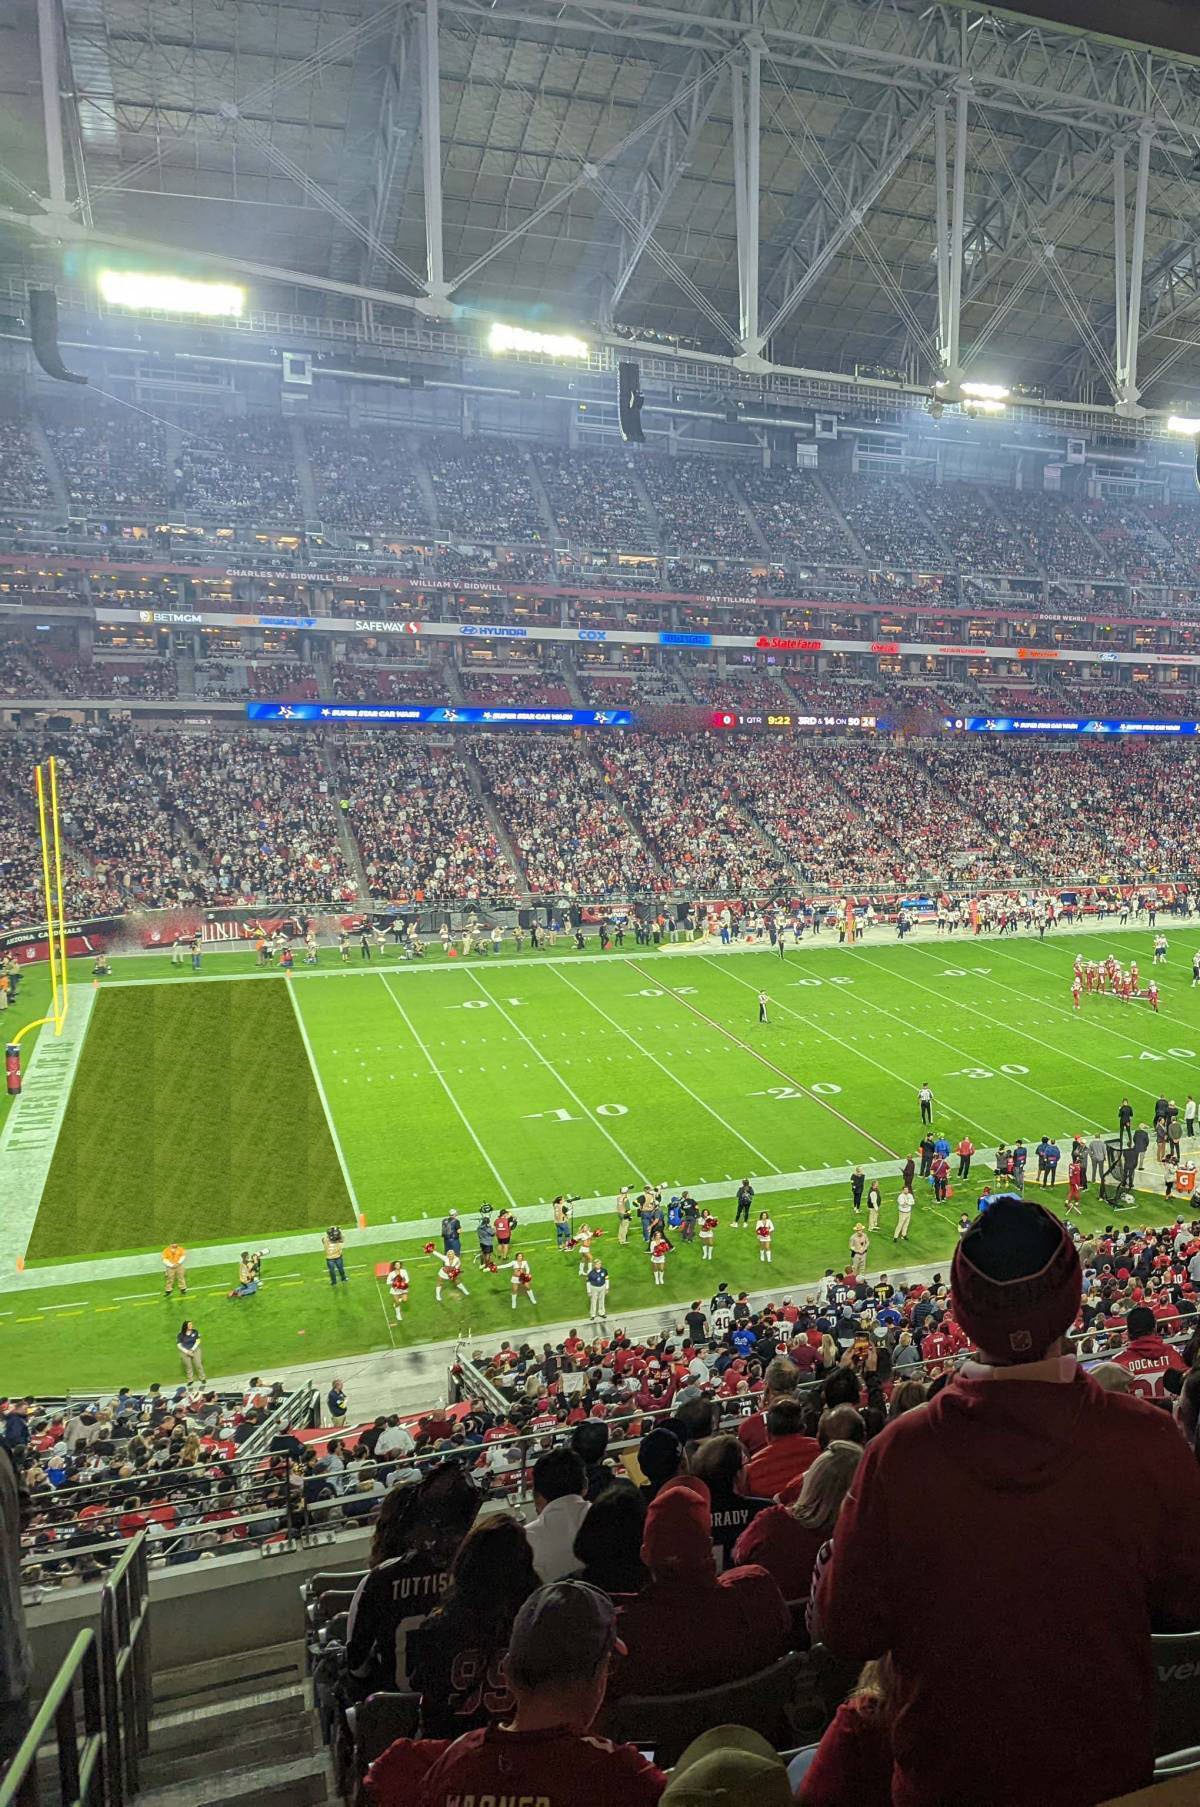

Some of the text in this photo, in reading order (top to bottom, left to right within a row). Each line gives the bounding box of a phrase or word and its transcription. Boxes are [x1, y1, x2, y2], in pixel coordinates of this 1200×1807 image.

[226, 569, 273, 578] CHARLES
[410, 580, 451, 588] WILLIAM
[463, 583, 503, 591] BIDWILL
[153, 613, 202, 622] BETMGM
[356, 620, 405, 631] SAFEWAY
[479, 627, 527, 636] HYUNDAI
[578, 630, 607, 640] COX
[739, 716, 744, 724] 1
[767, 716, 791, 725] 9:22
[798, 716, 817, 725] 3RD
[847, 717, 860, 726] 50
[7, 932, 37, 946] ARIZONA
[1139, 1048, 1197, 1061] 40
[960, 1065, 1030, 1078] 30
[13, 1095, 60, 1134] TAKES
[41, 1042, 75, 1055] US
[767, 1083, 842, 1099] 20
[1179, 1175, 1189, 1185] G
[1173, 1274, 1184, 1284] 10
[835, 1291, 846, 1302] 10
[715, 1316, 730, 1329] 40
[1128, 1355, 1170, 1372] DOCKETT
